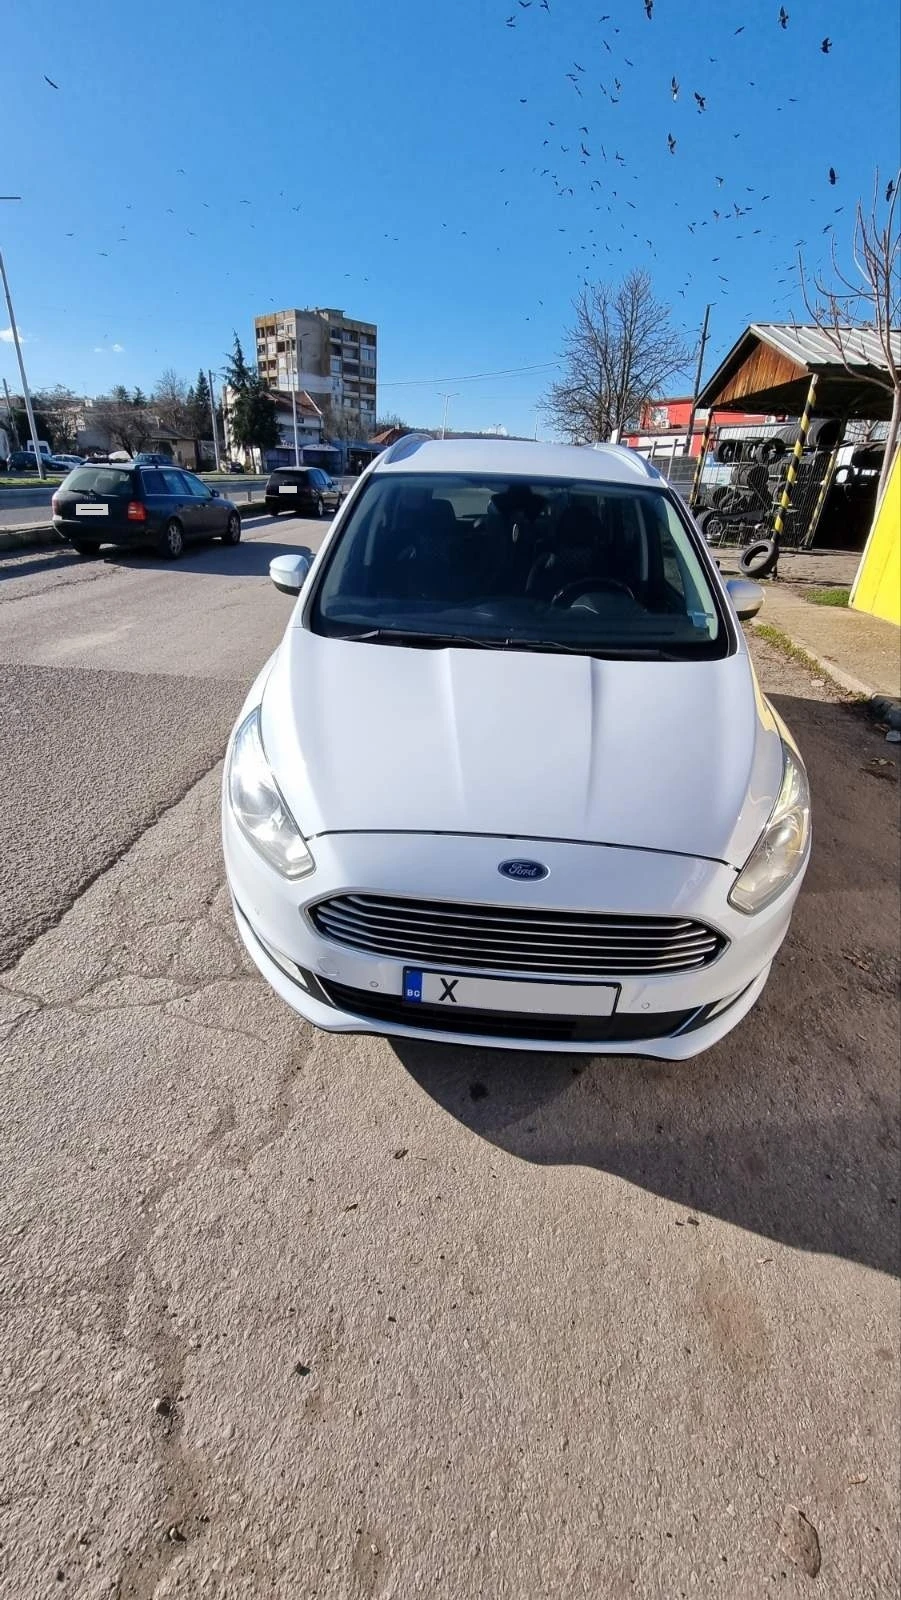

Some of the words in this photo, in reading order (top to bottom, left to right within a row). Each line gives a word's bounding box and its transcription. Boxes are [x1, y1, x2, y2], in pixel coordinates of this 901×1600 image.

[508, 863, 537, 876] Ford
[407, 989, 420, 997] BG
[438, 978, 459, 1002] X
